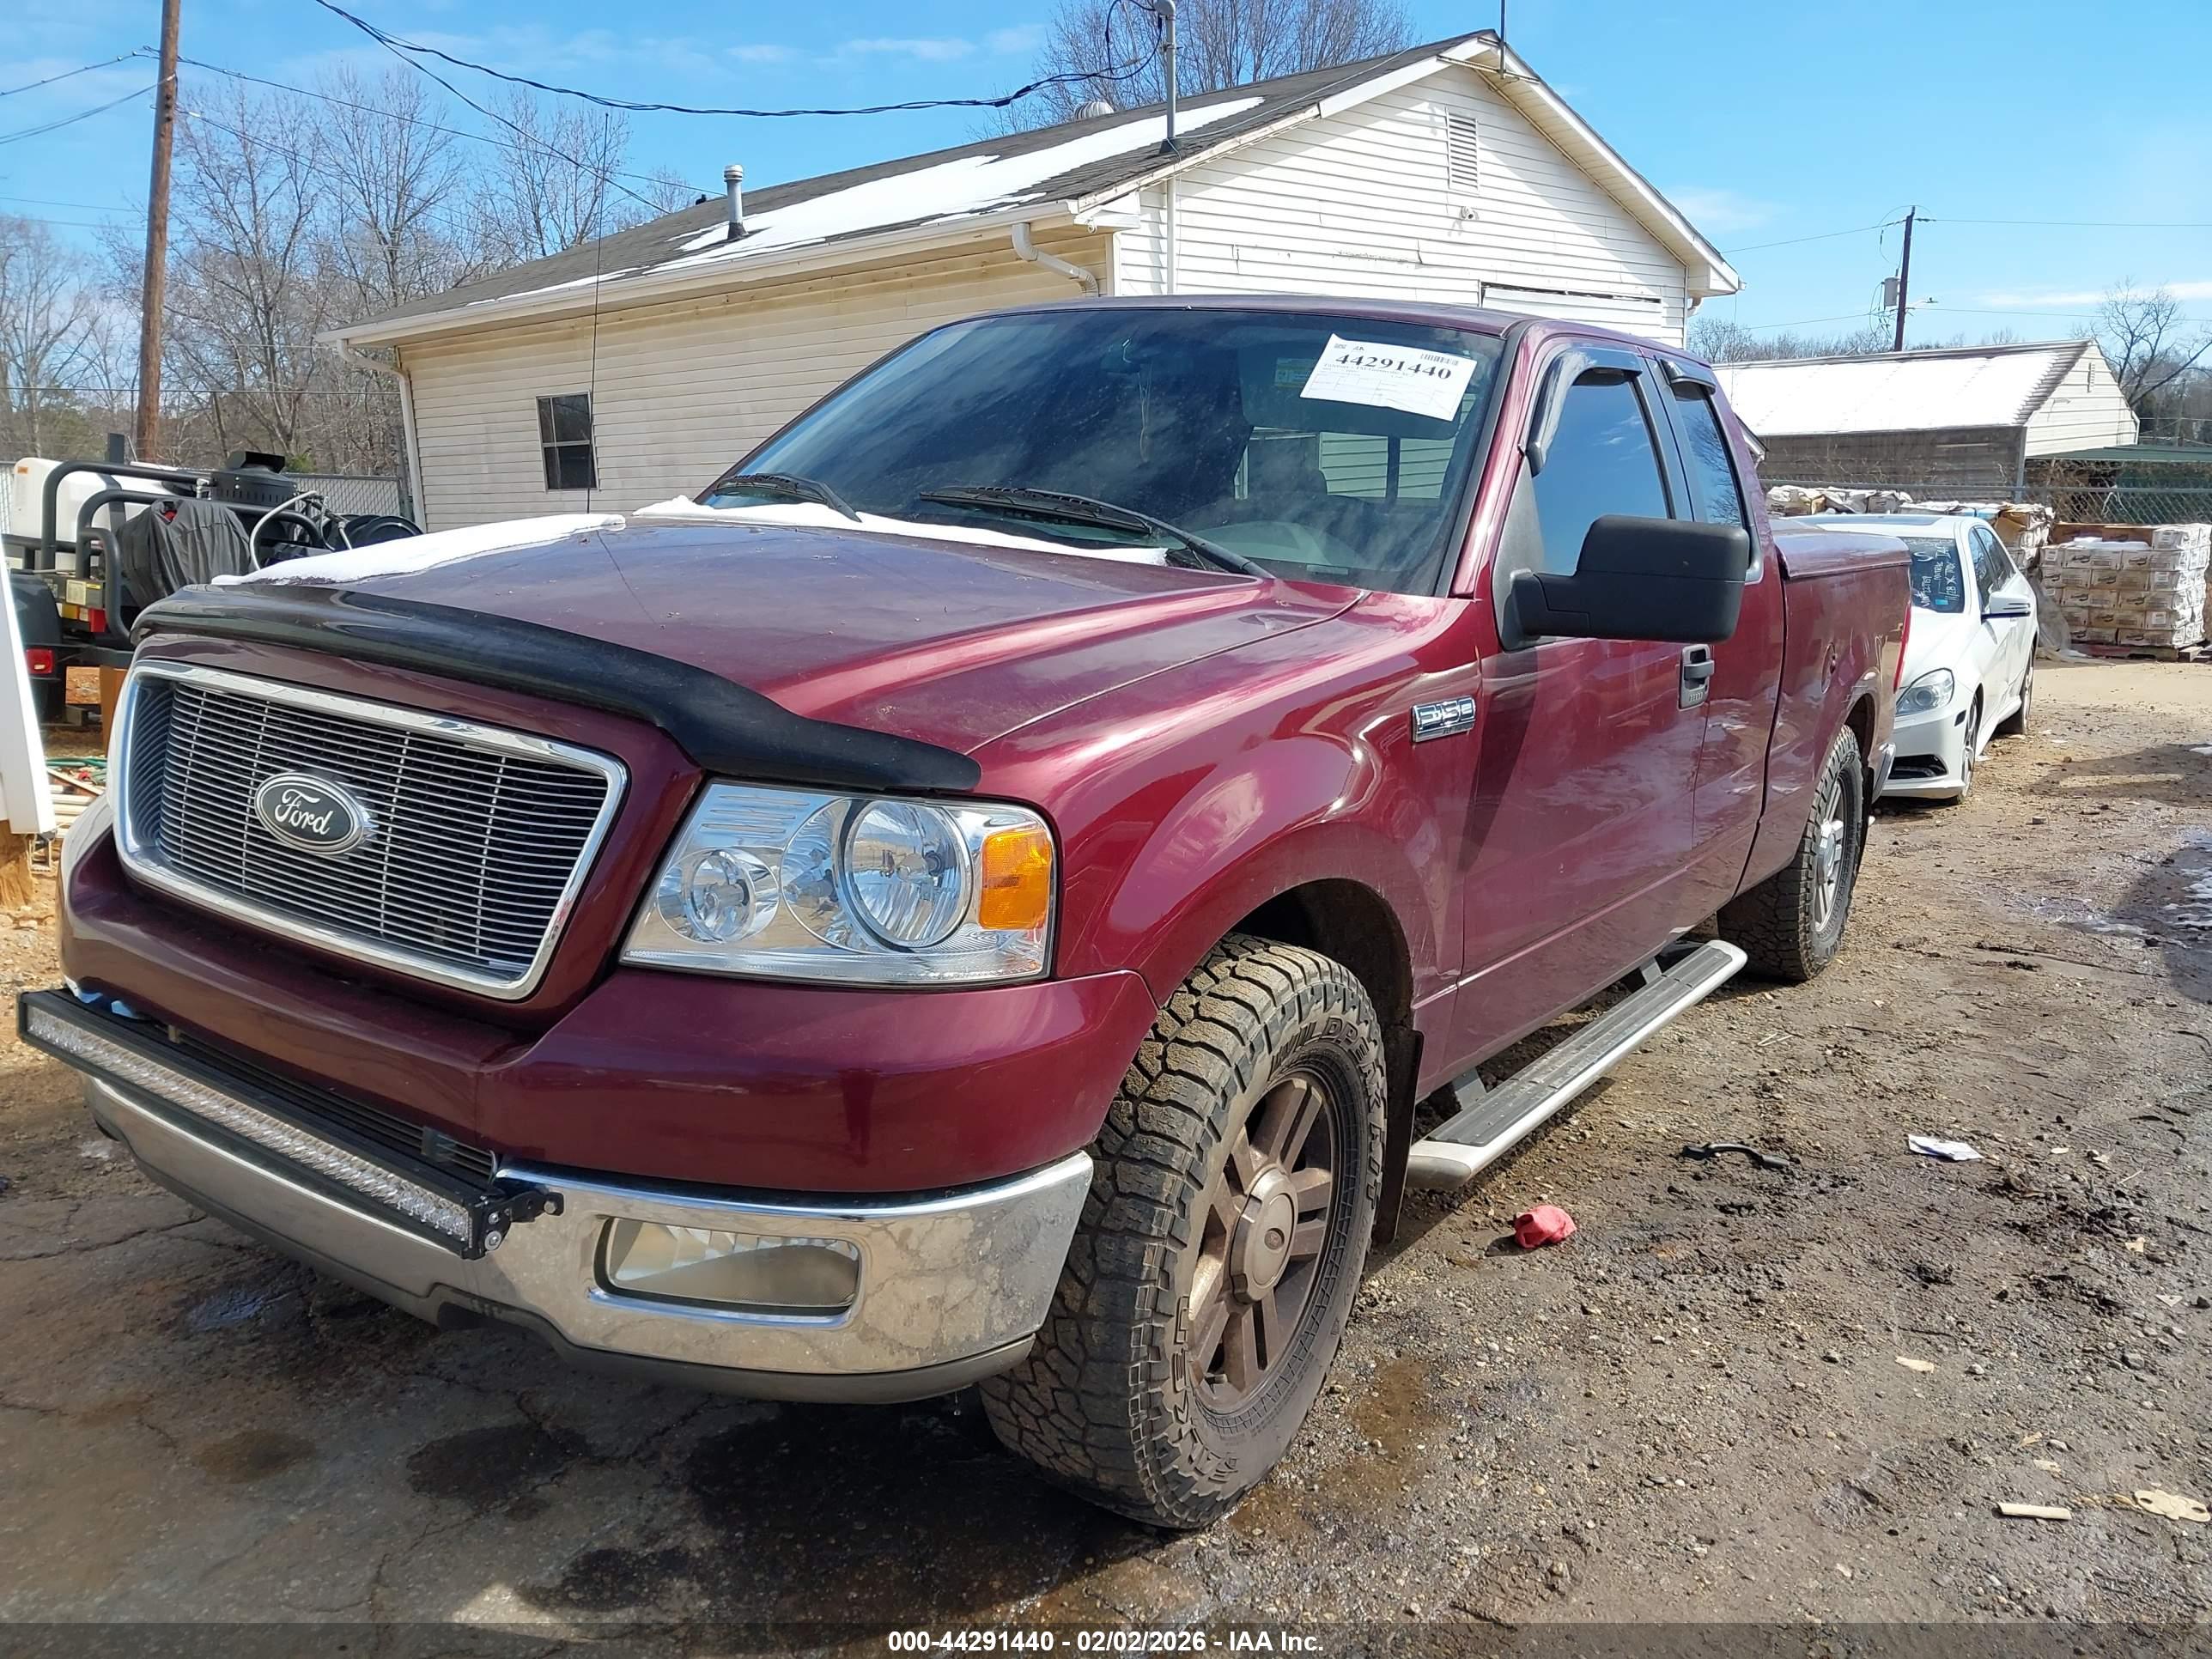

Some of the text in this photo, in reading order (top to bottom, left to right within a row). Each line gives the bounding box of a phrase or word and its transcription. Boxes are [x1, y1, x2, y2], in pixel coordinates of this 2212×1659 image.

[1335, 354, 1452, 380] 44291440
[275, 788, 334, 835] Ford
[1267, 1016, 1384, 1114] WILDPEAK
